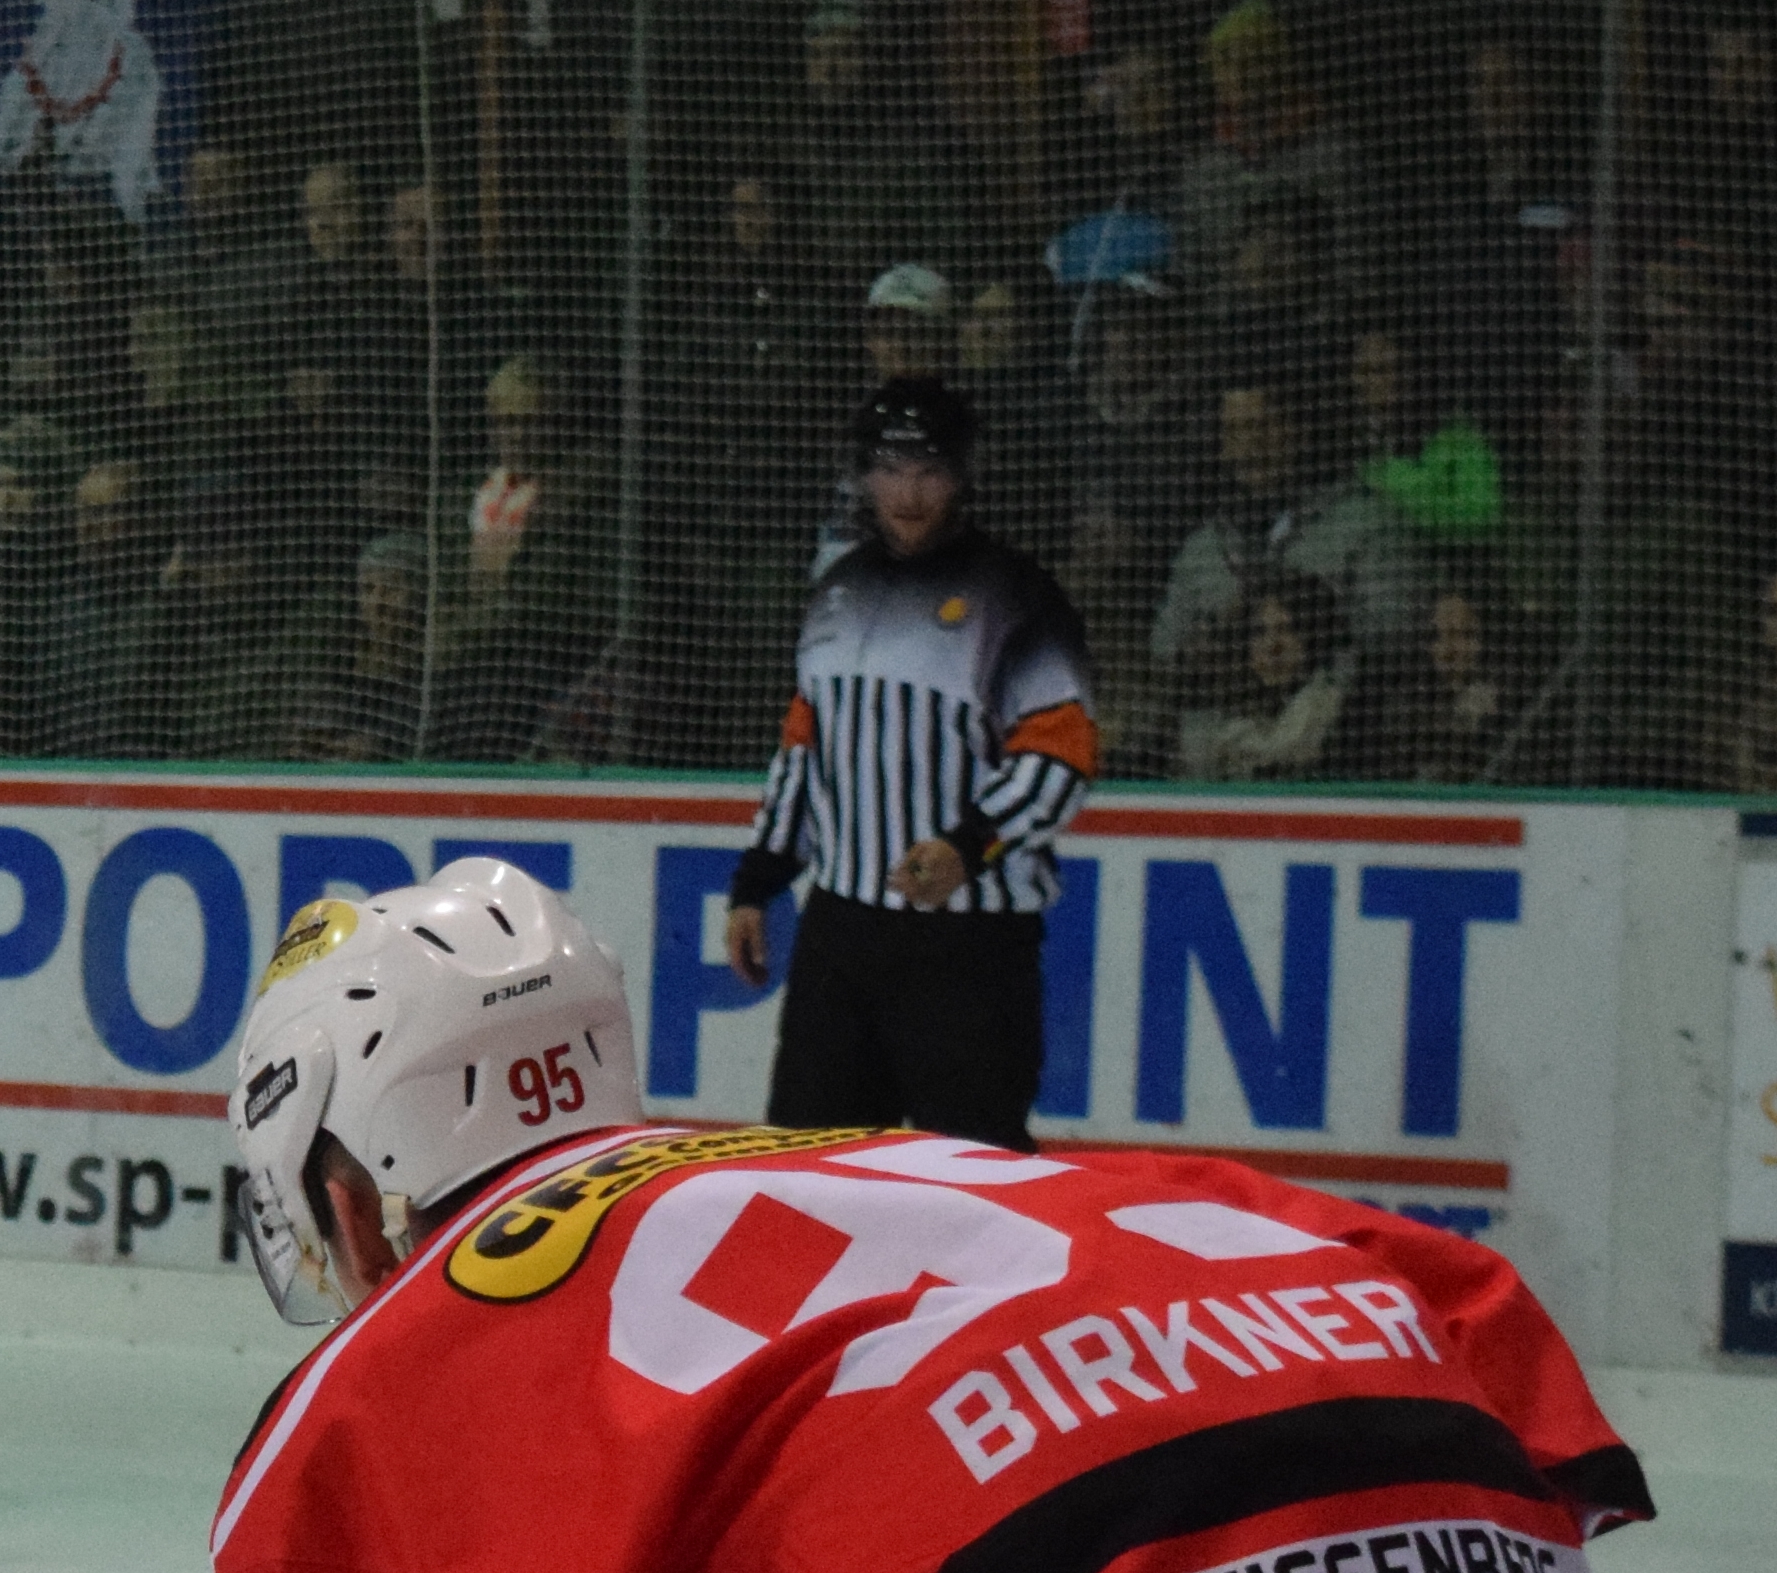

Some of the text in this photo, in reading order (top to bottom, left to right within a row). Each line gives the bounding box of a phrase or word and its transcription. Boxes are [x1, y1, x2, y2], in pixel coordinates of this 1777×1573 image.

[508, 1042, 585, 1126] 95
[646, 845, 1523, 1138] PINT
[927, 1280, 1443, 1485] BIRKNER
